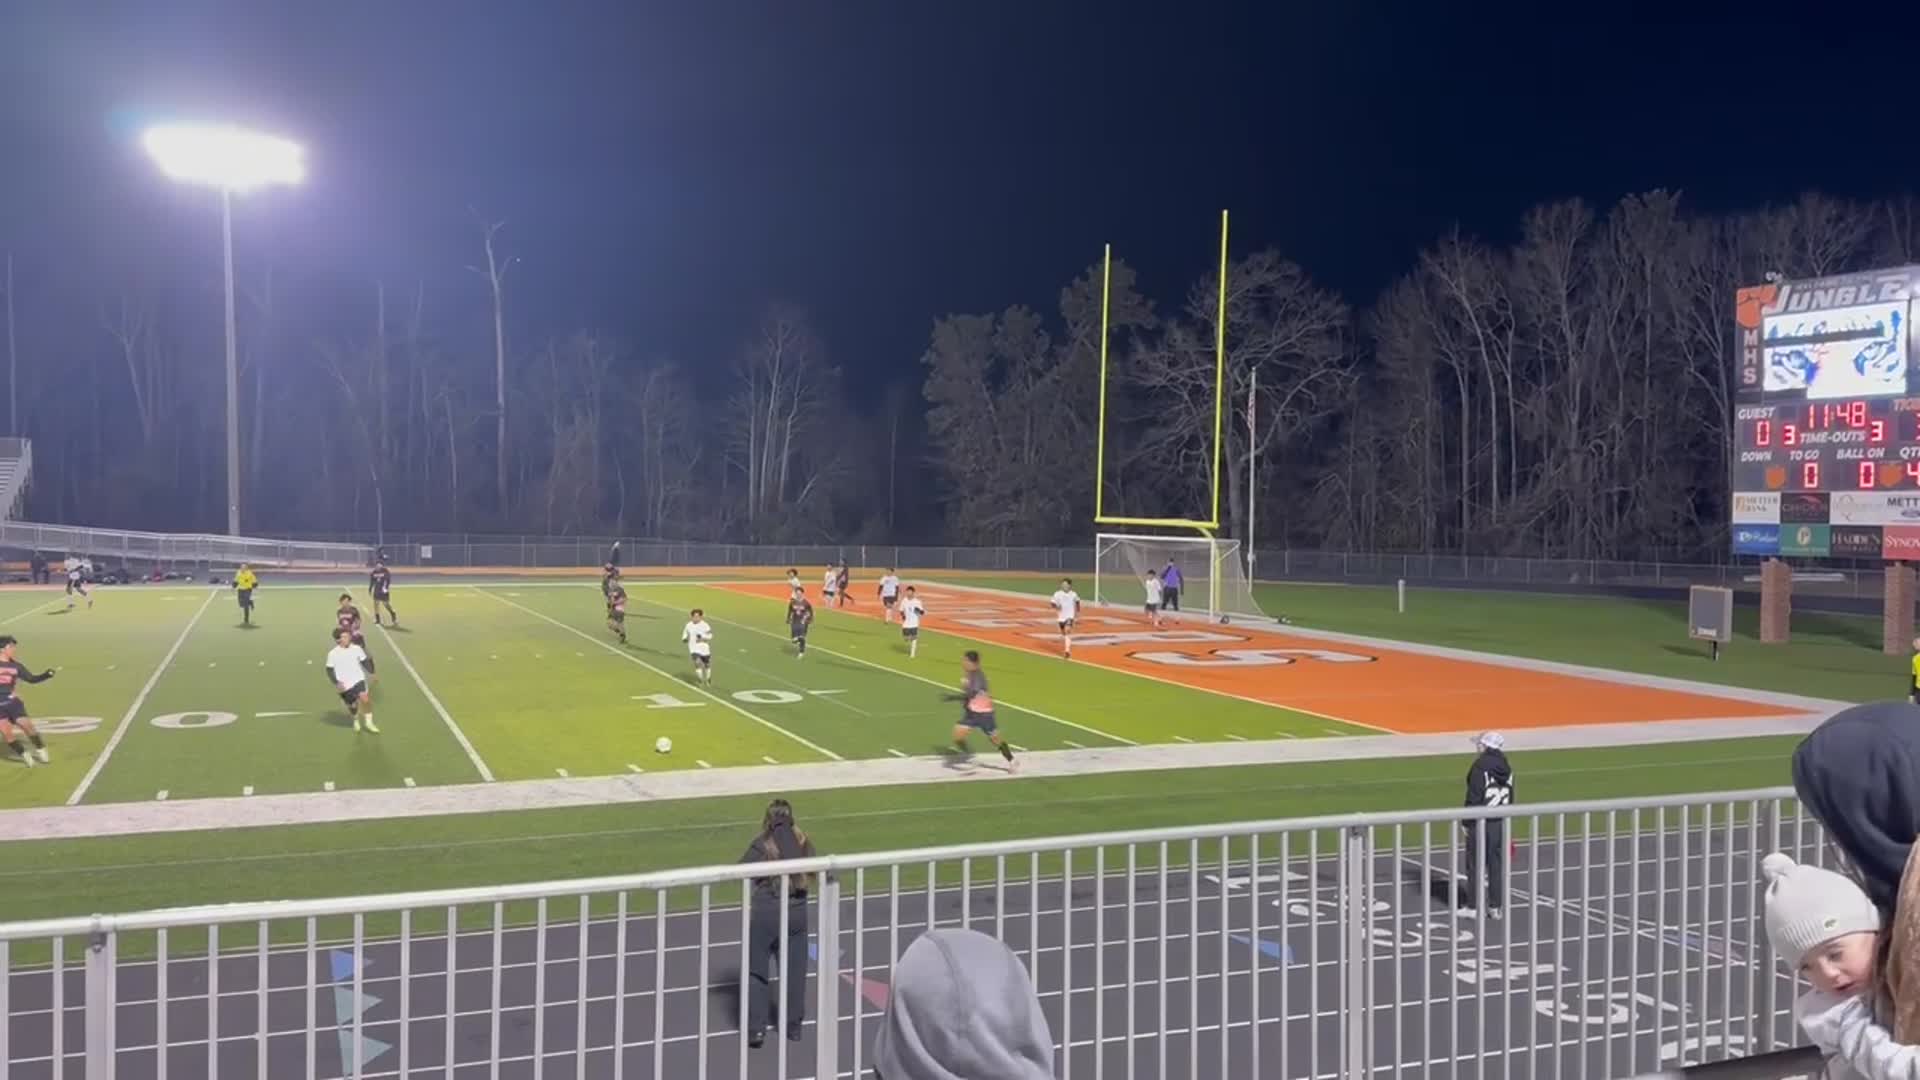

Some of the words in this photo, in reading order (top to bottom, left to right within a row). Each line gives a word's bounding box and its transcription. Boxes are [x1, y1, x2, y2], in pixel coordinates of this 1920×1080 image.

[1762, 275, 1911, 315] JUNGLE
[1743, 329, 1758, 384] MHS
[1738, 407, 1776, 420] GUEST
[1809, 401, 1866, 429] 11:48
[1756, 421, 1770, 446] 0
[1784, 425, 1796, 445] 3
[1800, 431, 1866, 443] TIME-OUTS
[1872, 421, 1884, 441] 3
[1741, 452, 1772, 462] DOWN
[1790, 450, 1803, 461] TO
[1804, 450, 1820, 460] GO
[1837, 450, 1865, 460] BALL
[1867, 448, 1885, 459] ON
[1804, 462, 1818, 488] 0
[1860, 461, 1874, 488] 0
